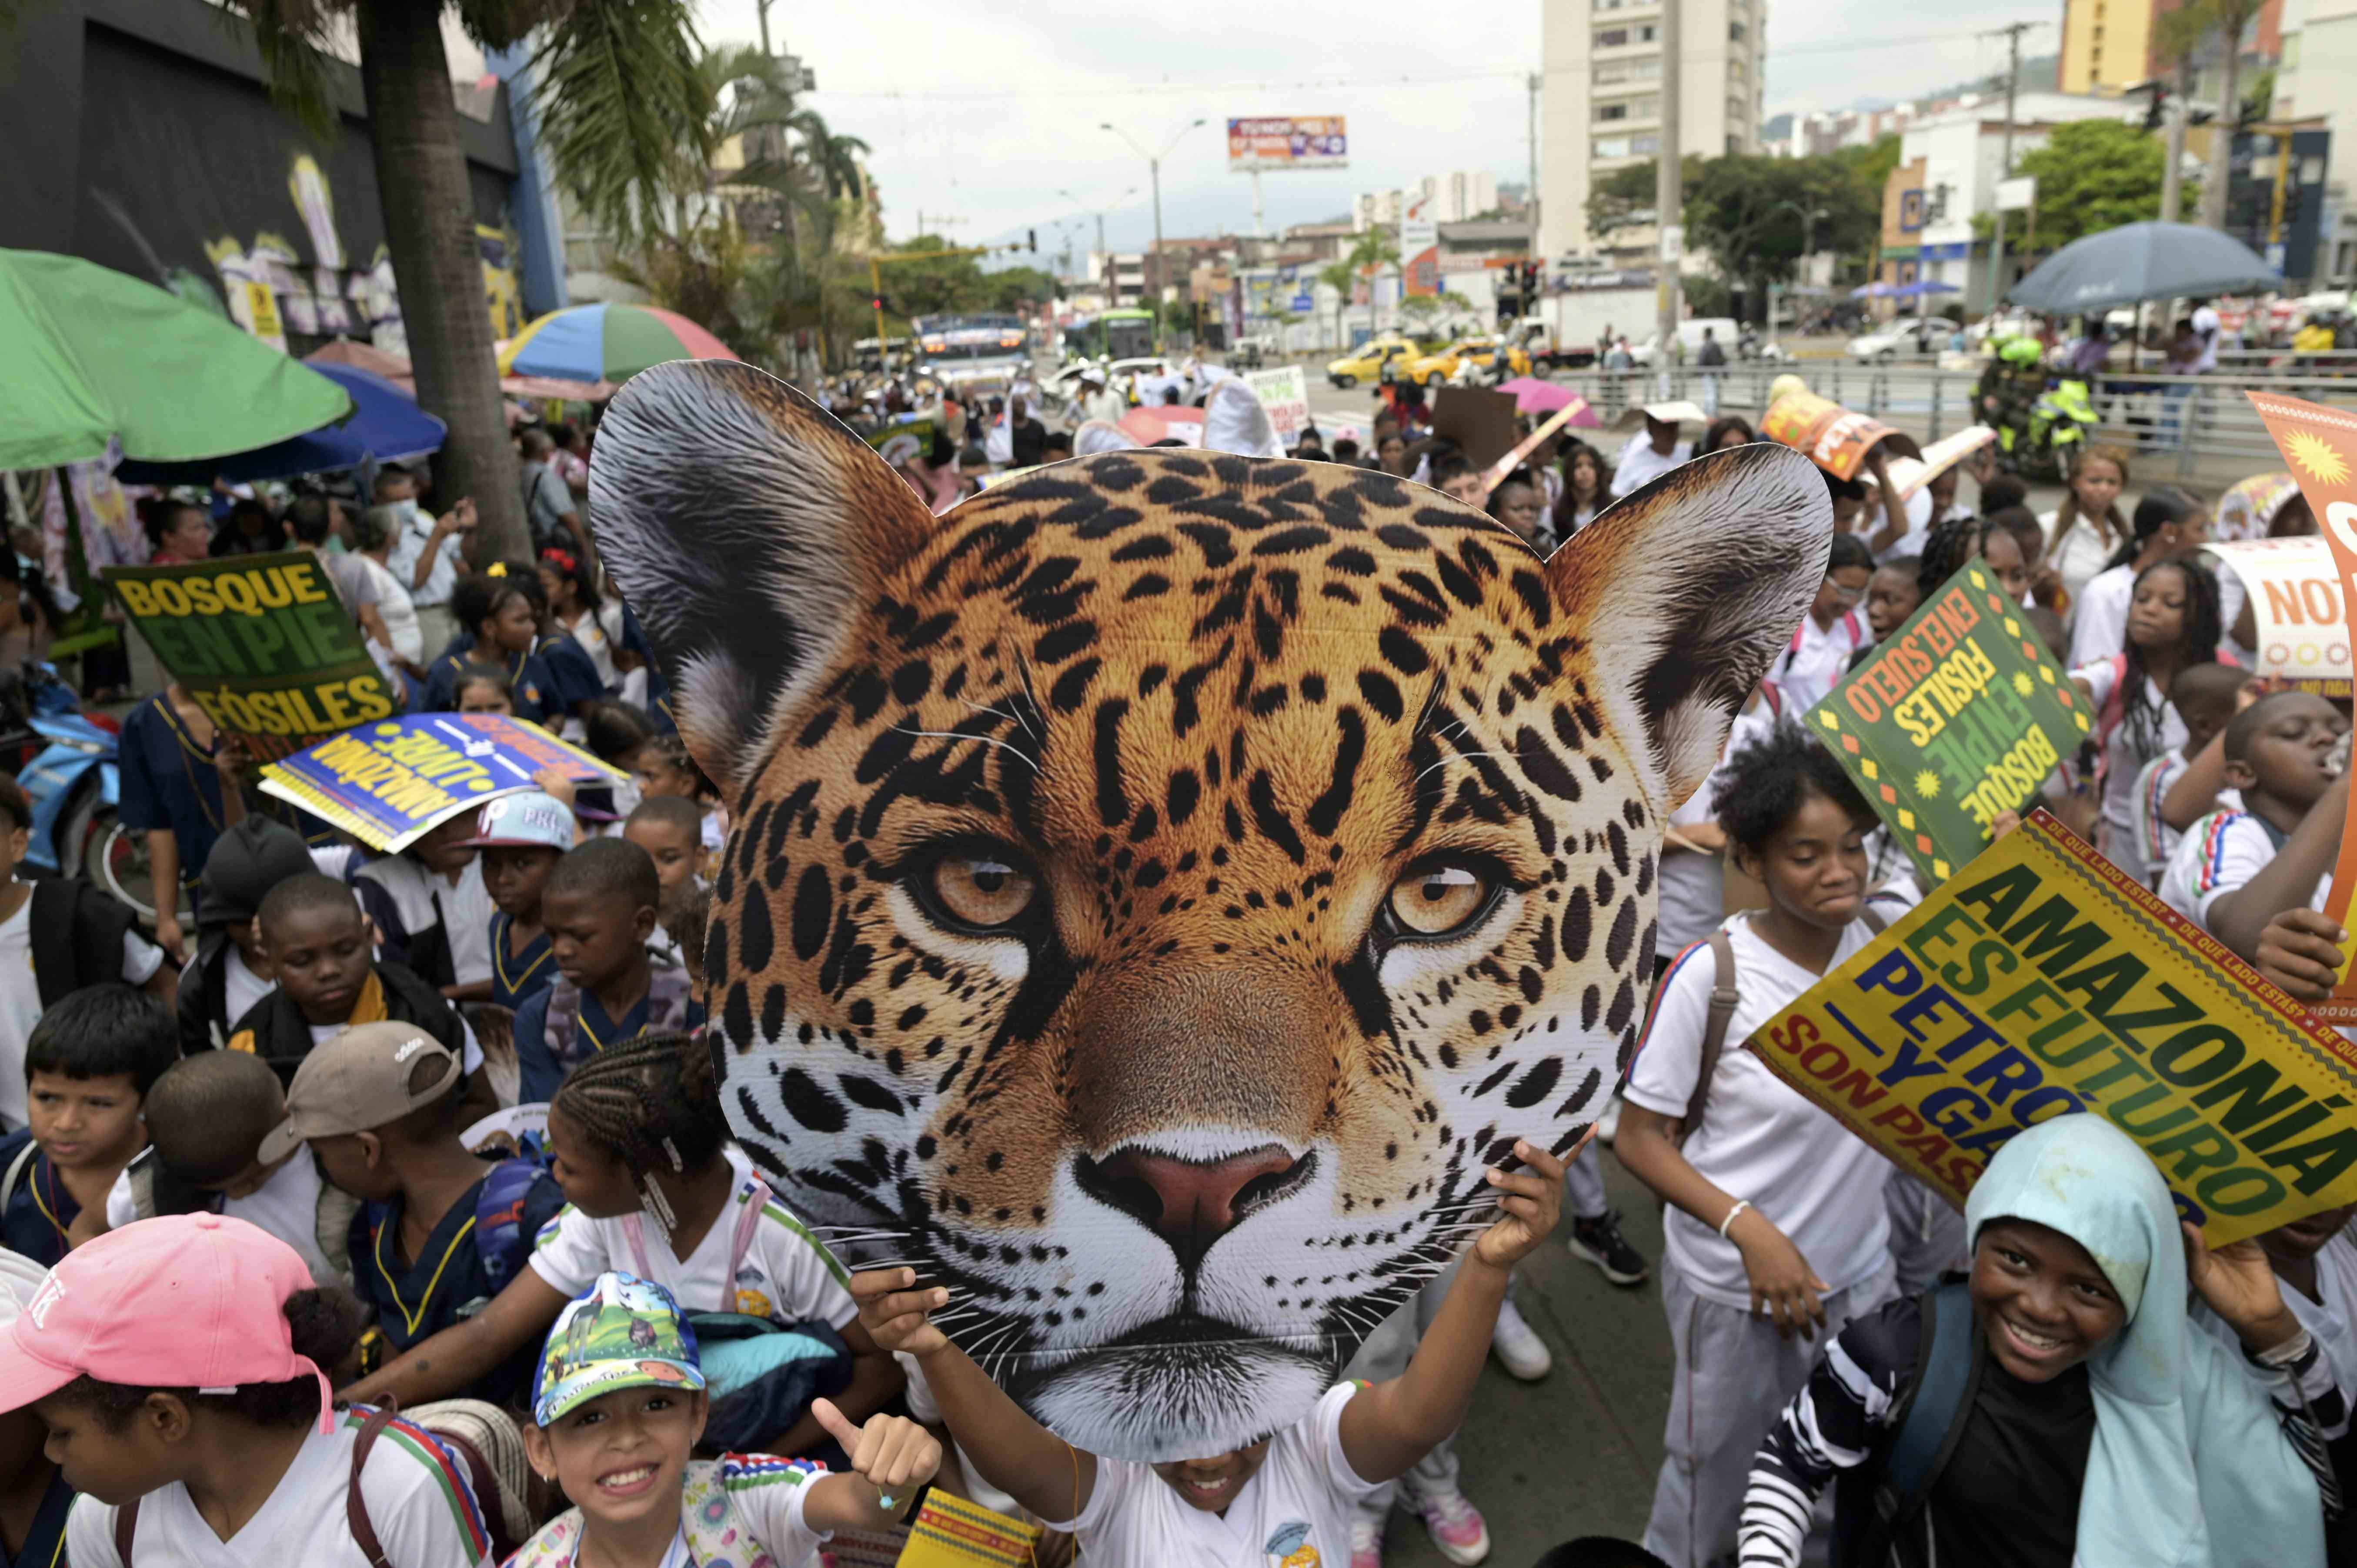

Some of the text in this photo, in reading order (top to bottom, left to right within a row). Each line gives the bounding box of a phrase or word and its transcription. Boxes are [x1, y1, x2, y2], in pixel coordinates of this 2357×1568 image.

[116, 564, 327, 617] BOSQUE
[239, 604, 361, 672] PIE
[193, 676, 393, 735] FÓSILES
[1846, 587, 1980, 723] EN EL SUELO
[1893, 637, 1996, 747] FÓSILES
[372, 729, 491, 788] LIVRE
[1922, 674, 2033, 800] EN PIE
[1959, 724, 2058, 841] BOSQUE
[2047, 822, 2067, 837] DE
[2090, 857, 2123, 883] LADO
[2178, 923, 2199, 939] DE
[2224, 956, 2260, 985] LADO
[2316, 1026, 2337, 1043] DE
[1769, 1014, 1889, 1109] SON
[1876, 1038, 1947, 1088] Y
[1904, 904, 2287, 1216] ES FUTURO
[1955, 863, 2357, 1196] AMAZONÍA
